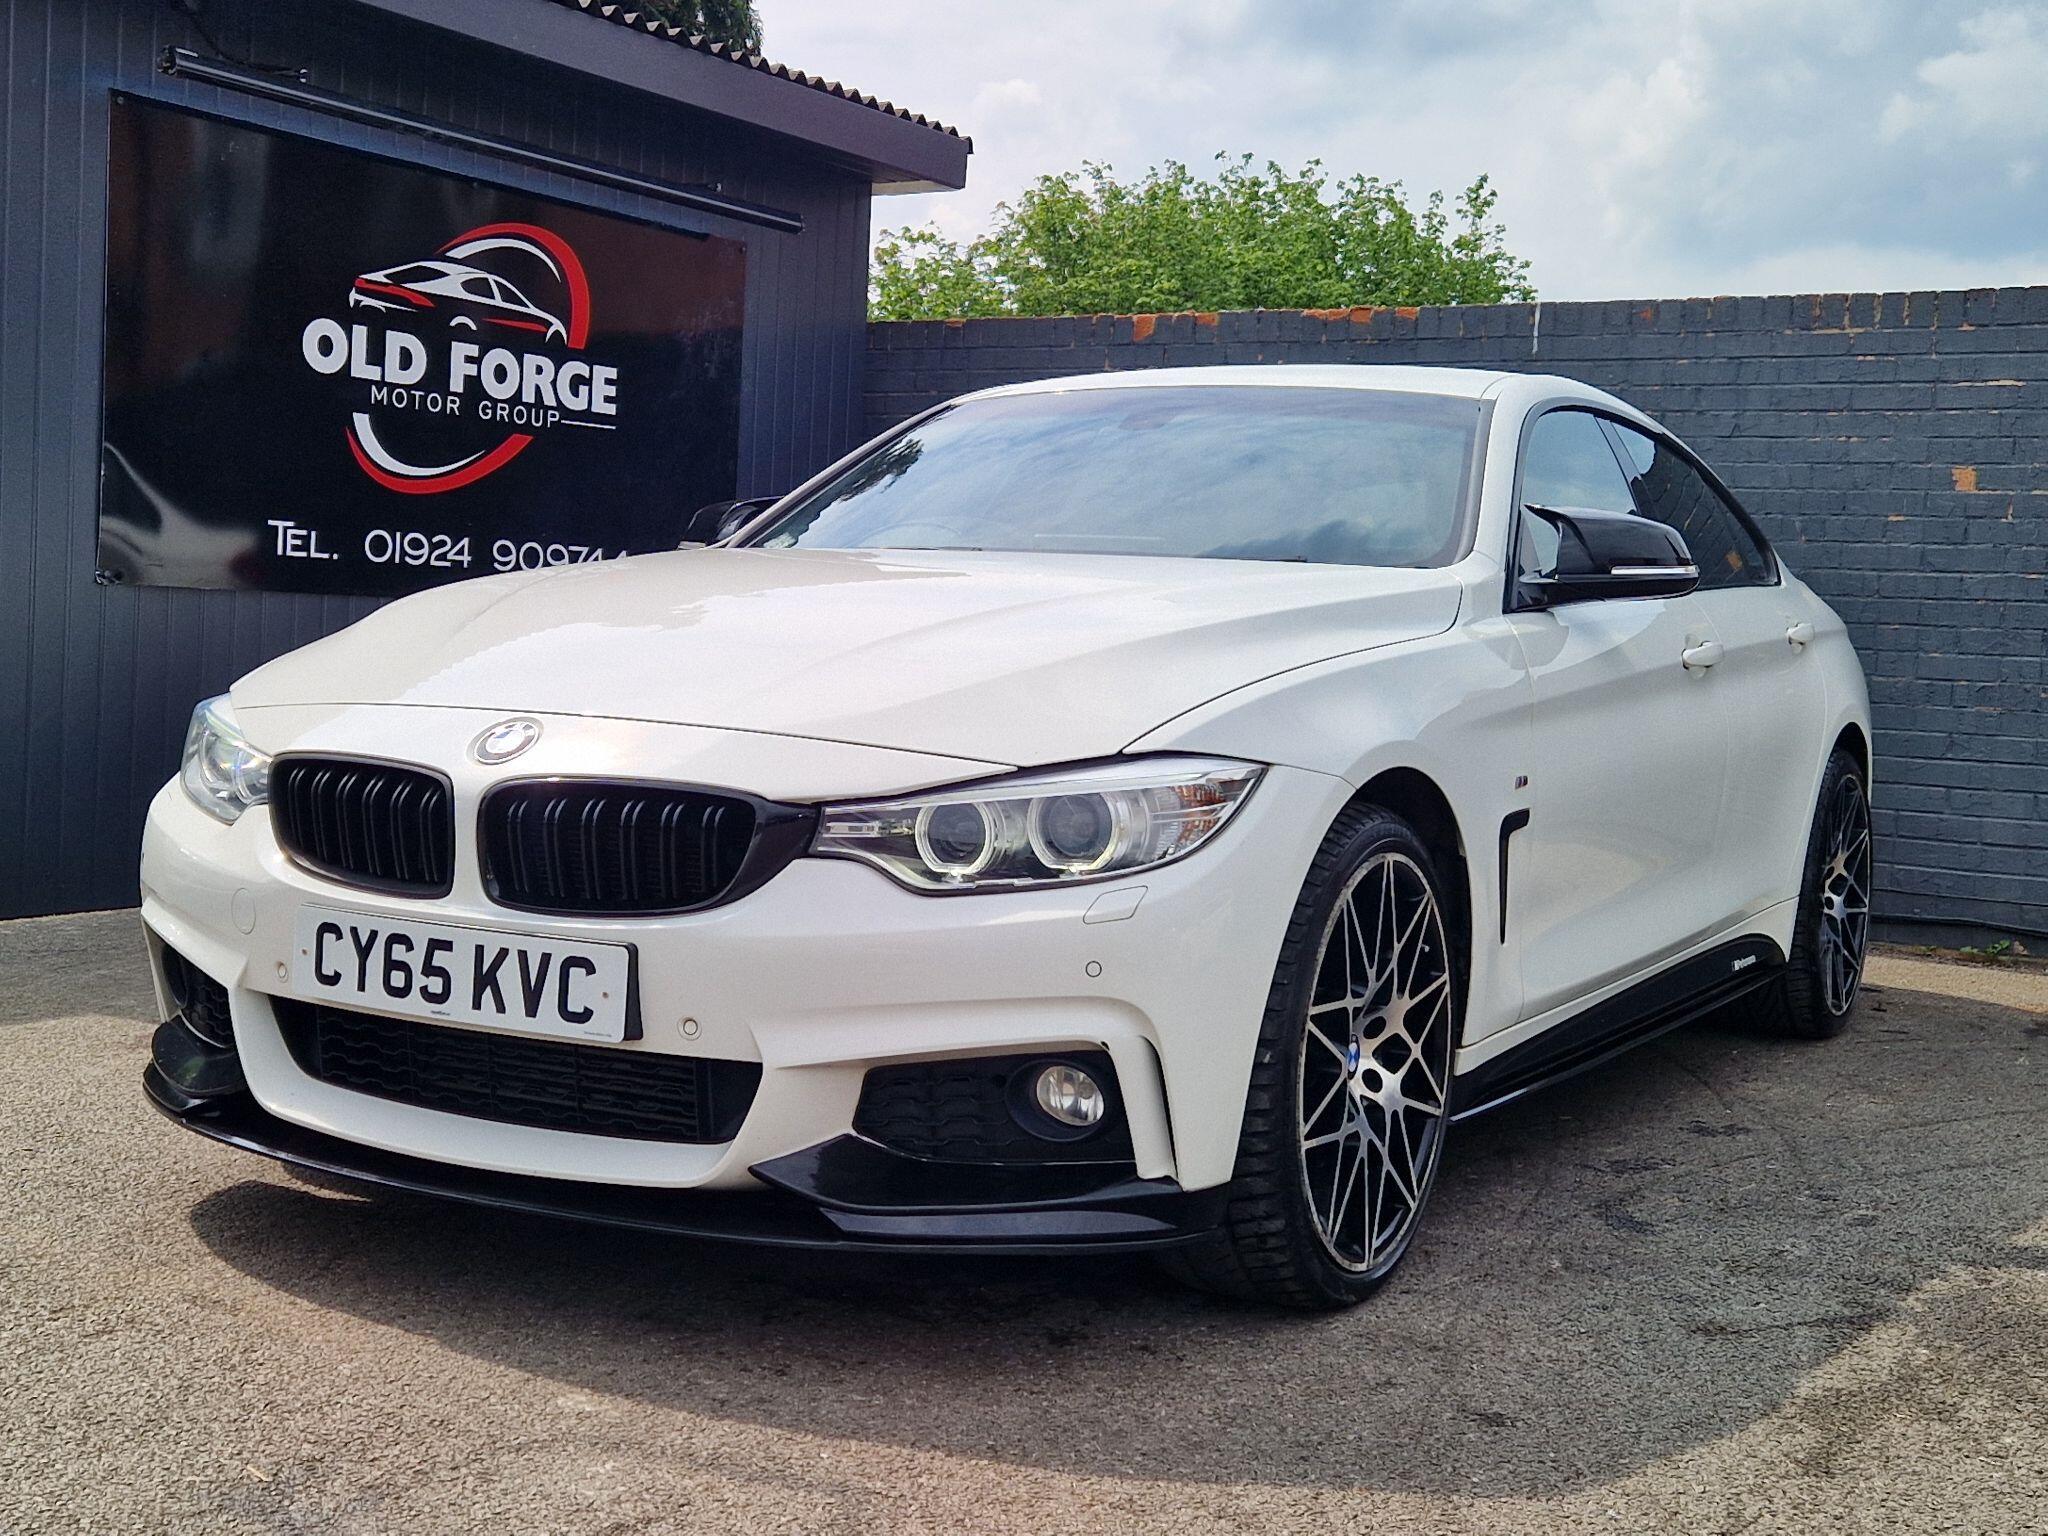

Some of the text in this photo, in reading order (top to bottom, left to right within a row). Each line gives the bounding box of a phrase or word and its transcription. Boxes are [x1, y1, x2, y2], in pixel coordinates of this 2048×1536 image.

[302, 317, 617, 415] OLD FORGE
[370, 384, 560, 428] MOTOR GROUP
[267, 519, 338, 560] TEL.
[364, 529, 472, 568] 01924
[314, 921, 597, 1025] CY65 KVC
